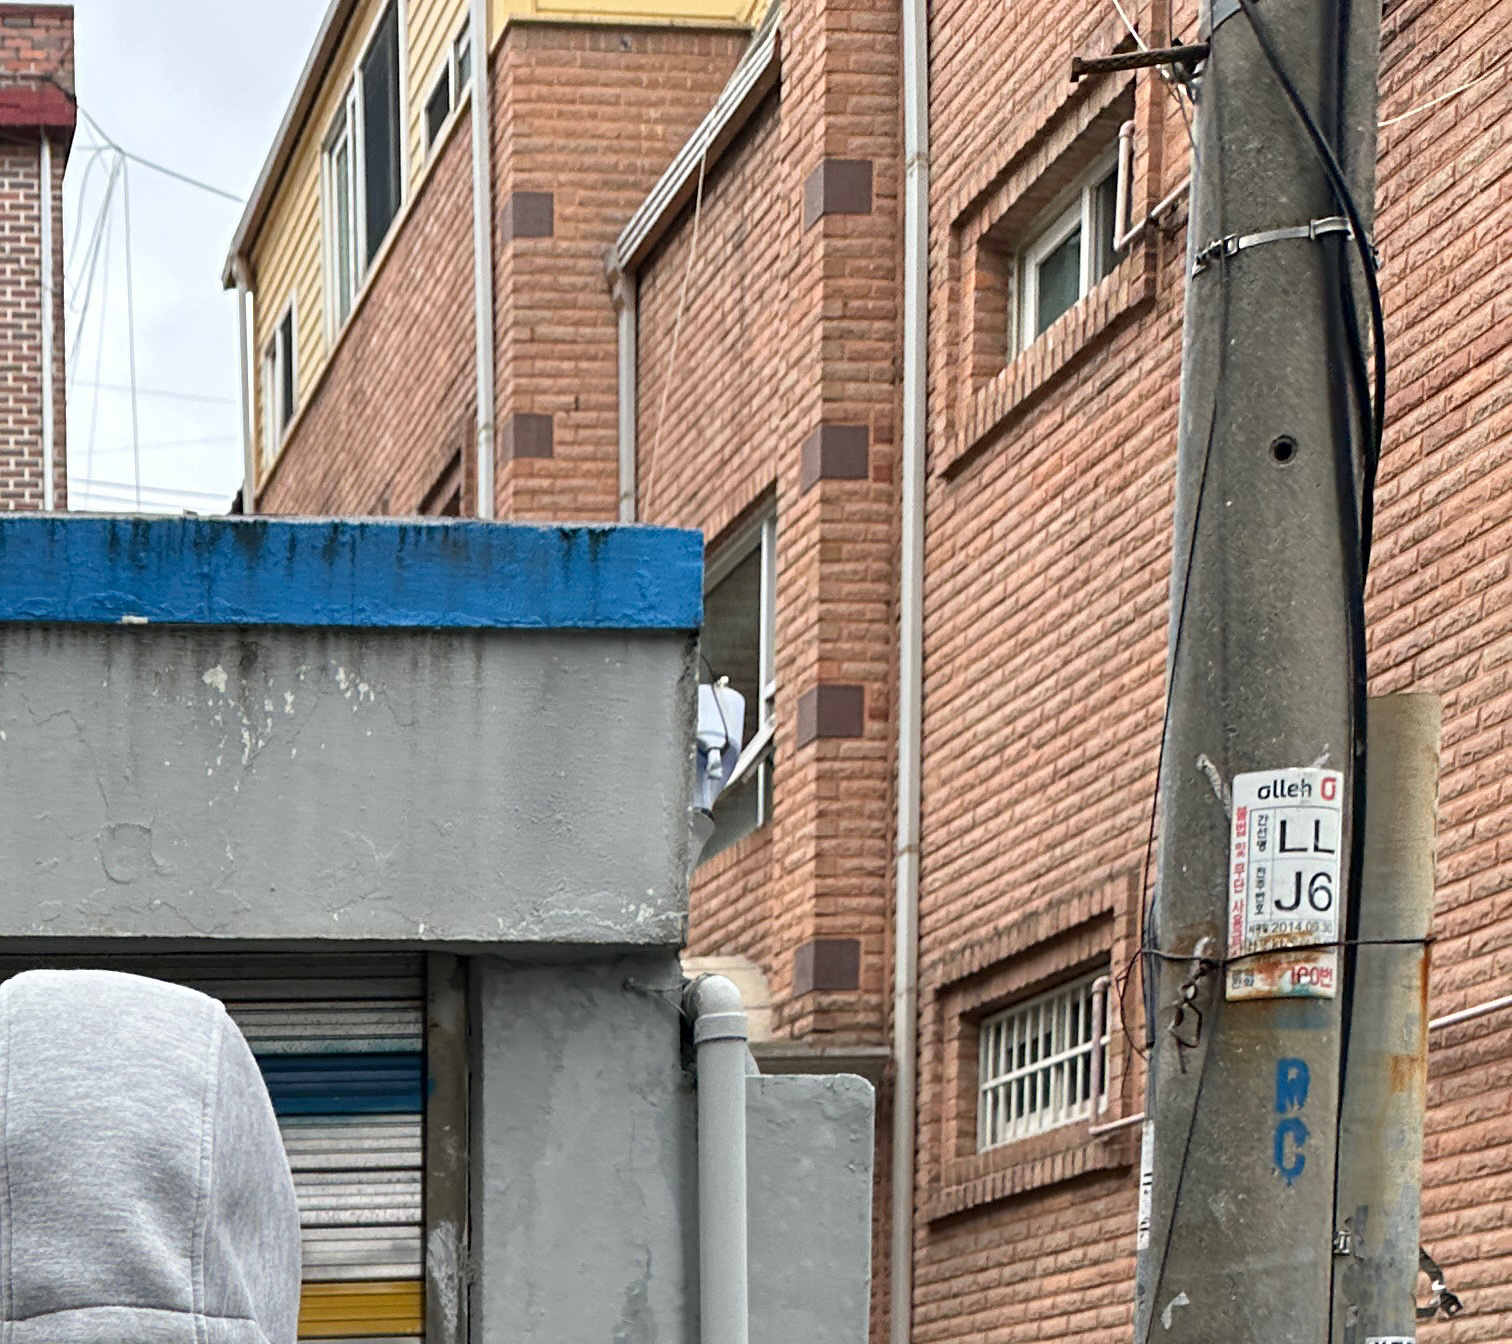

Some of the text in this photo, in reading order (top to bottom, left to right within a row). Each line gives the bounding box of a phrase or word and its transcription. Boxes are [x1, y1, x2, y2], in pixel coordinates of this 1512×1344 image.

[1257, 778, 1312, 800] olleh
[1278, 819, 1335, 855] LL
[1274, 870, 1333, 913] J6
